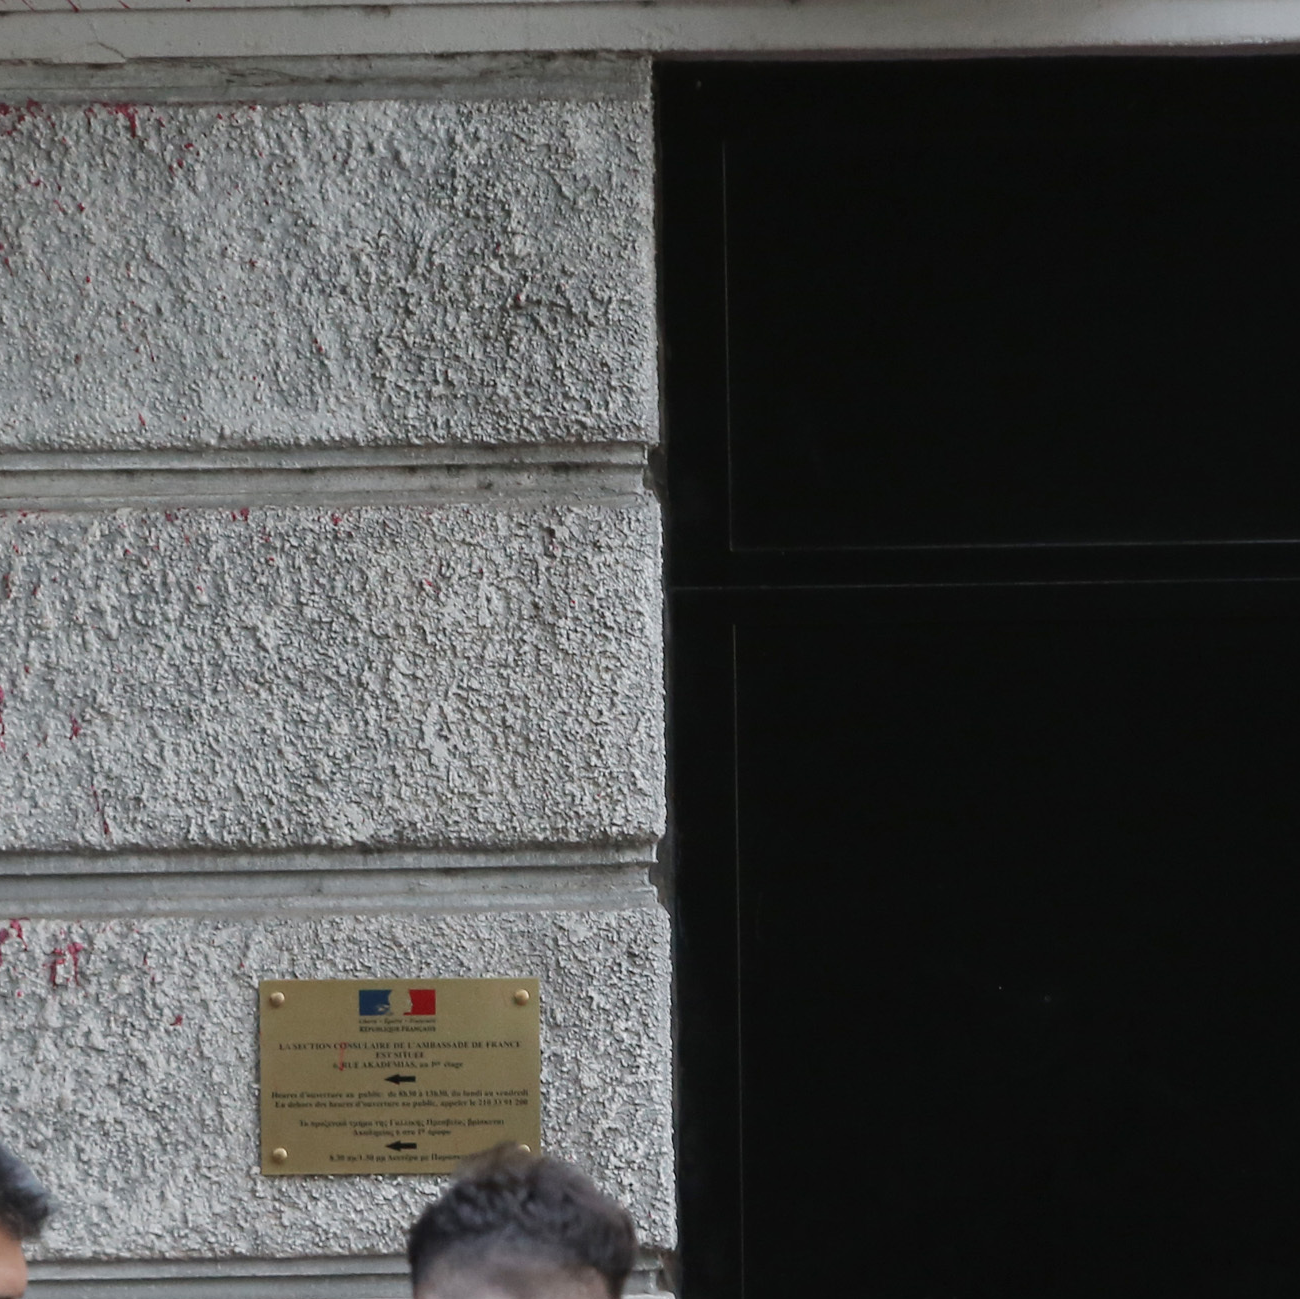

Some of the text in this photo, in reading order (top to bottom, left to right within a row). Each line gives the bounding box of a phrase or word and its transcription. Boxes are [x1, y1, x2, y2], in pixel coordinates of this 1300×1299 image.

[333, 1042, 390, 1050] CONSULAIRE
[486, 1040, 521, 1048] FRANCE
[341, 1061, 358, 1069] RUE
